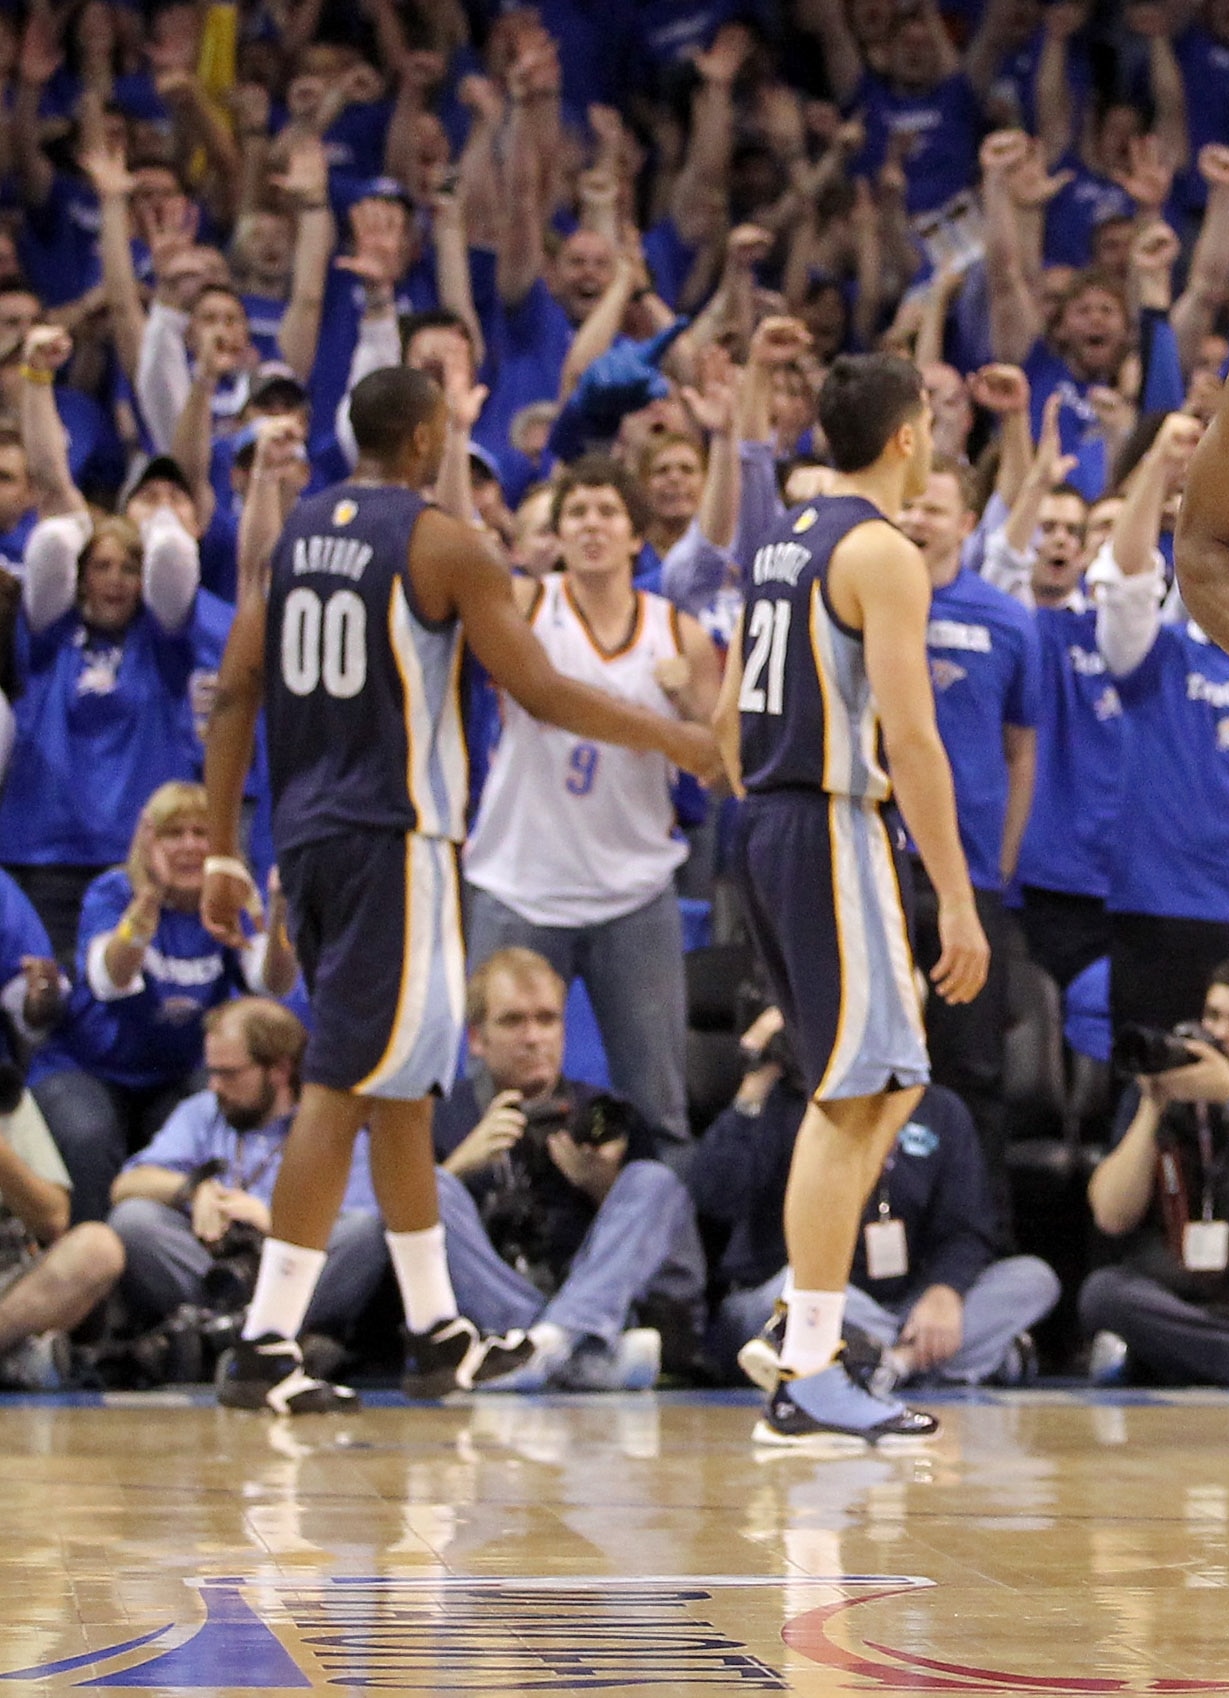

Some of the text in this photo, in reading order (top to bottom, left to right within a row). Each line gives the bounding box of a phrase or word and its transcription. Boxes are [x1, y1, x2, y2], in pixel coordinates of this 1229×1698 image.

[281, 586, 367, 699] 00
[737, 599, 792, 715] 21
[565, 741, 599, 797] 9
[274, 1588, 791, 1691] PLAYOFFS
